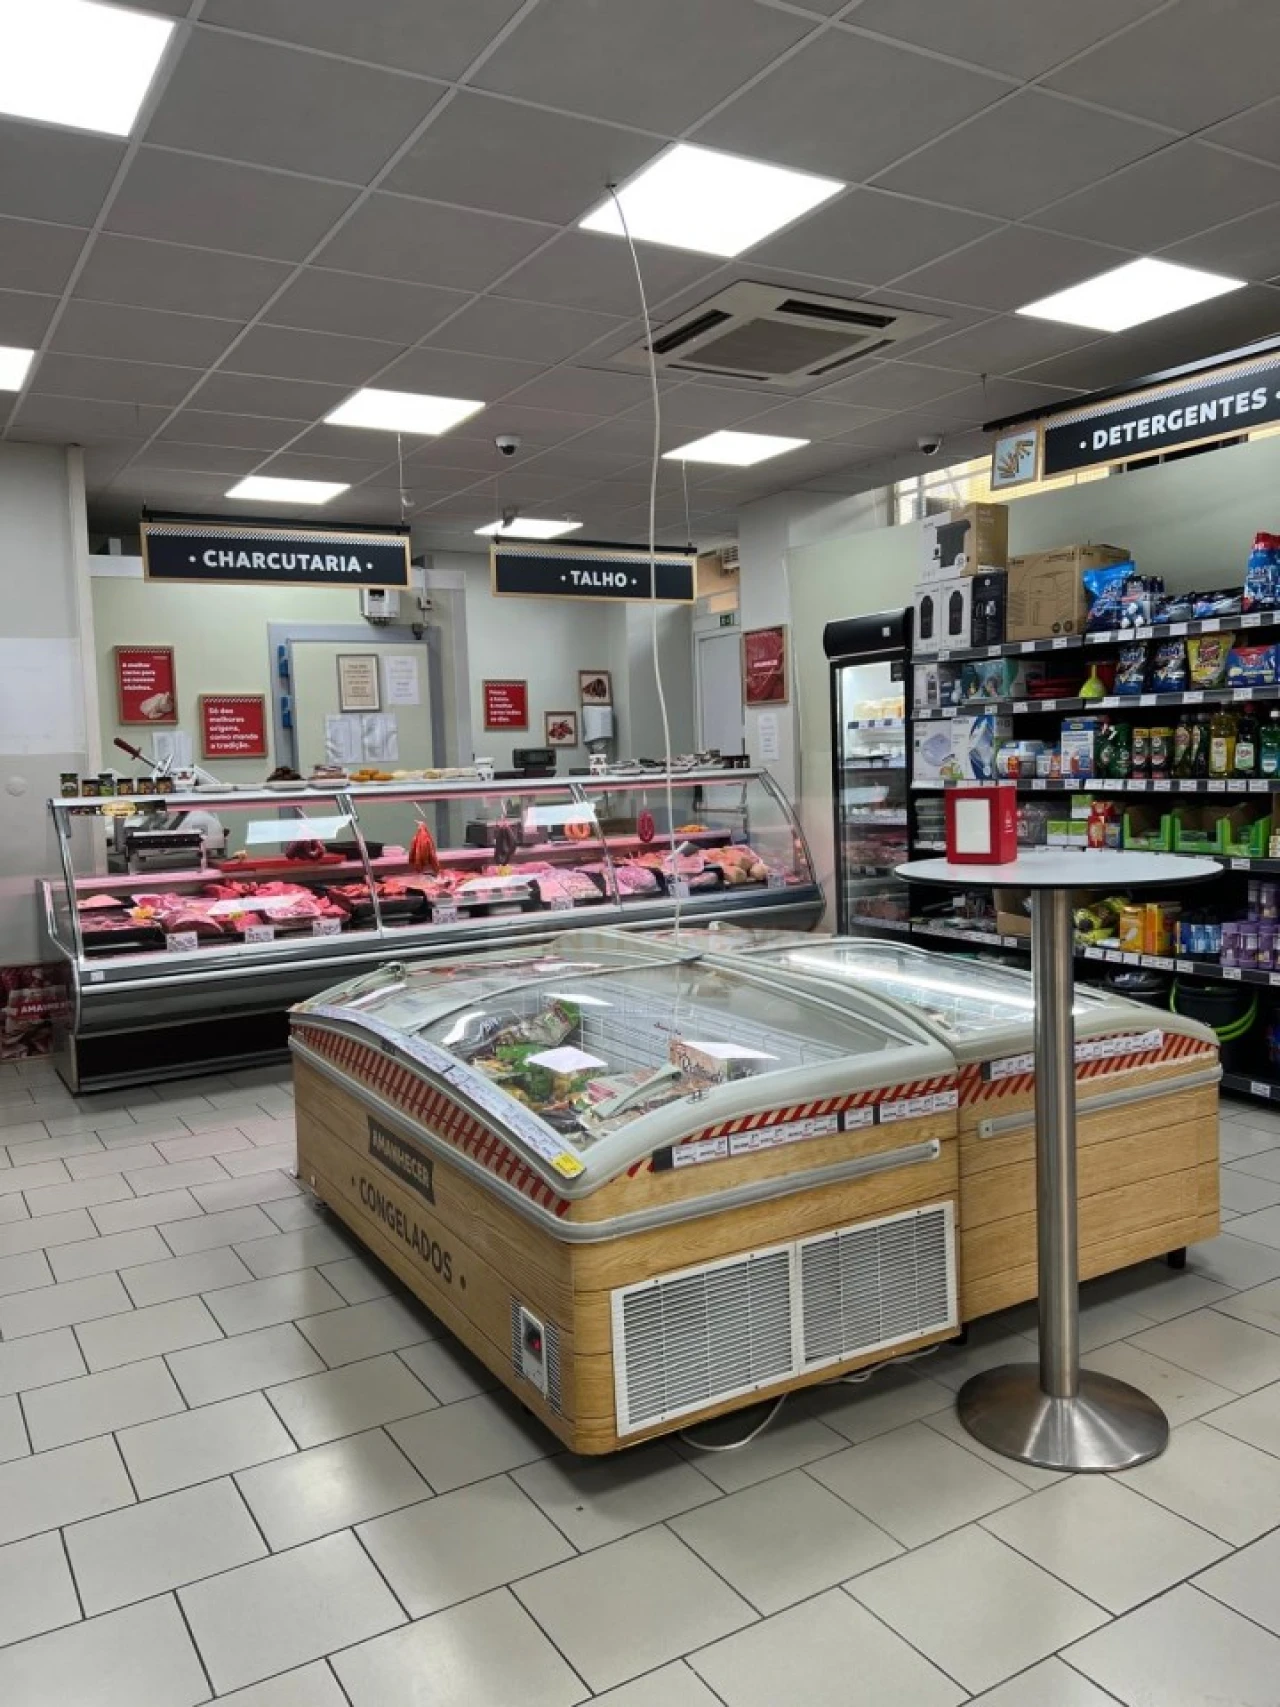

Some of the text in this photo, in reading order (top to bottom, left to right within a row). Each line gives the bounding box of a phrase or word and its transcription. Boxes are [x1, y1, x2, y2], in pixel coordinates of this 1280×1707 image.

[1092, 387, 1267, 451] DETERGENTES
[202, 549, 362, 573] CHARCUTARIA
[570, 570, 627, 588] TALHO
[359, 1176, 453, 1284] CONGELADOS
